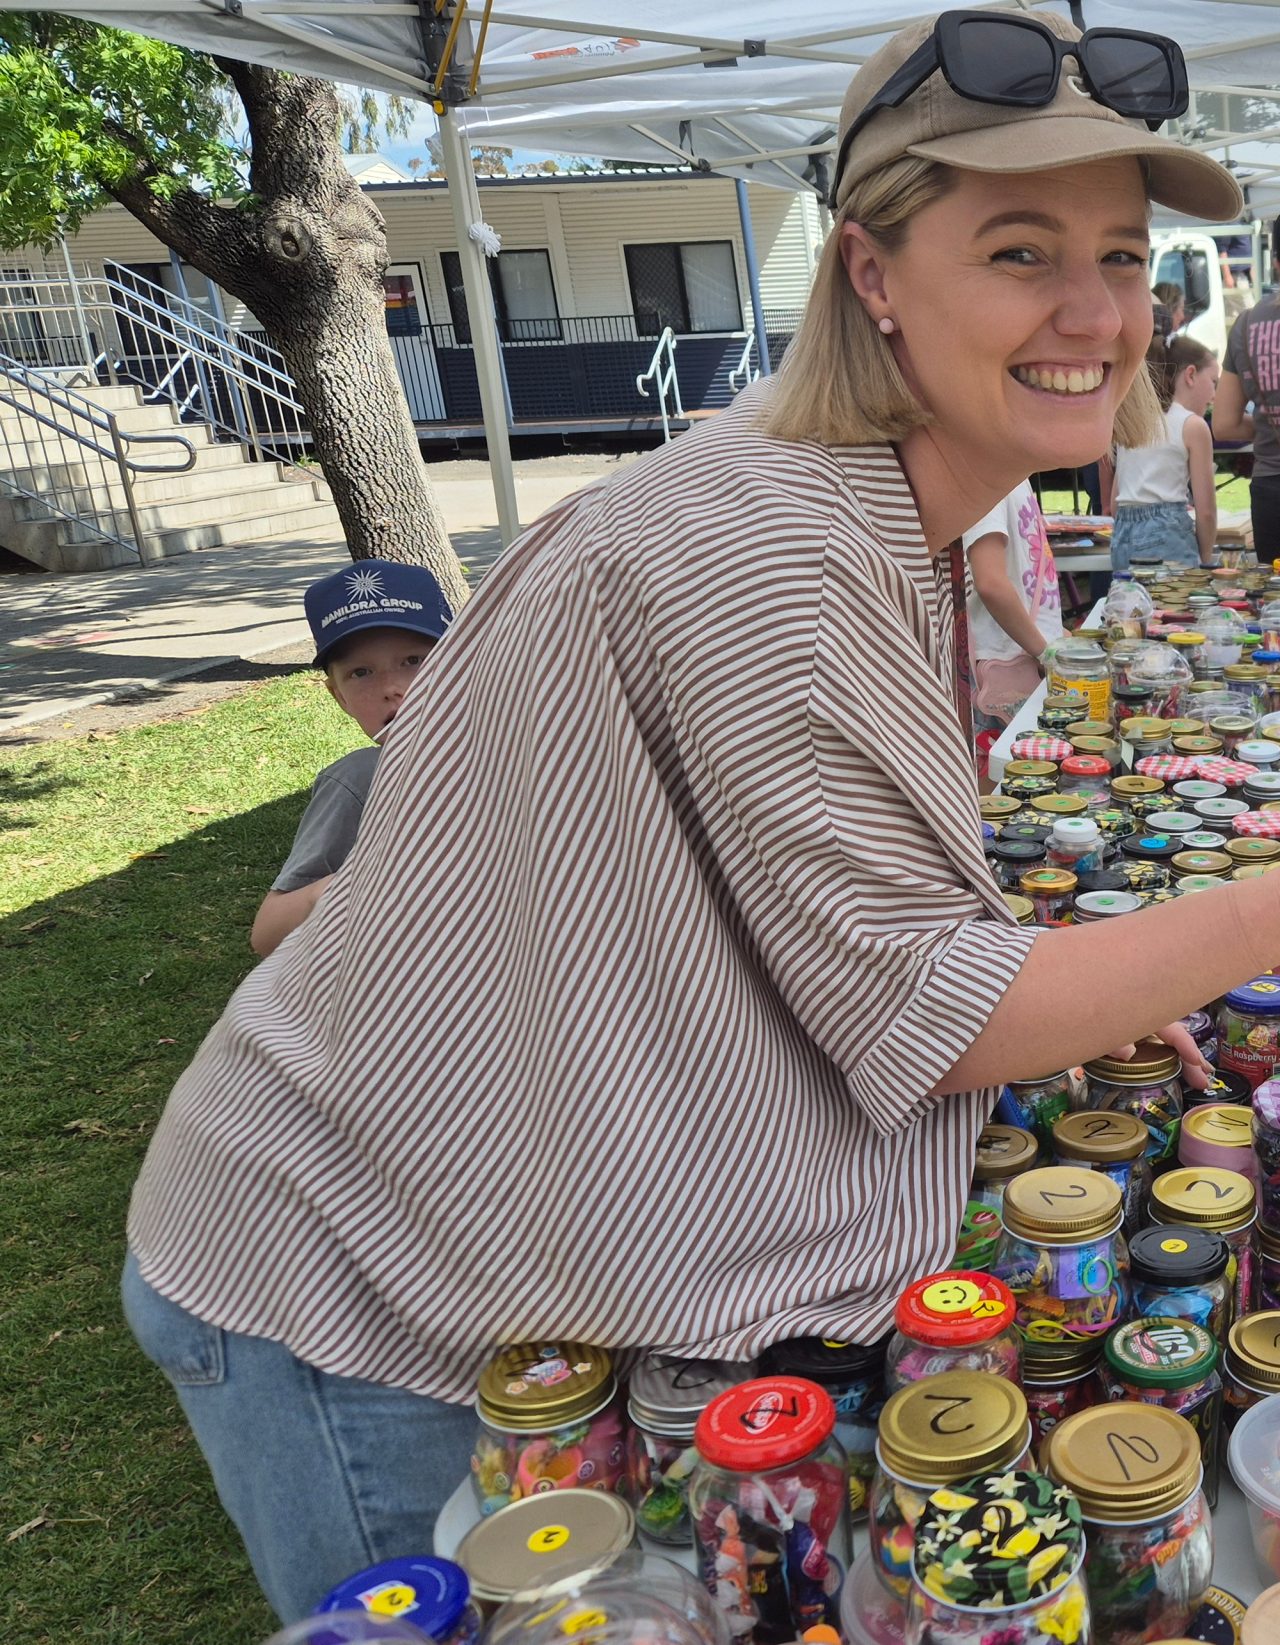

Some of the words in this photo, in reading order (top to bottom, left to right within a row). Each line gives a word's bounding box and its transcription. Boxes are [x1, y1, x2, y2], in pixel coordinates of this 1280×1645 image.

[321, 600, 378, 628] MANILDRA
[380, 598, 423, 611] GROUP
[348, 607, 383, 619] AUSTRALIAN
[1233, 1051, 1277, 1062] Raspberry
[1083, 1119, 1125, 1139] 2
[1039, 1184, 1087, 1206] 2
[1186, 1179, 1235, 1199] 2
[924, 1394, 975, 1436] 2
[1107, 1430, 1160, 1480] 2
